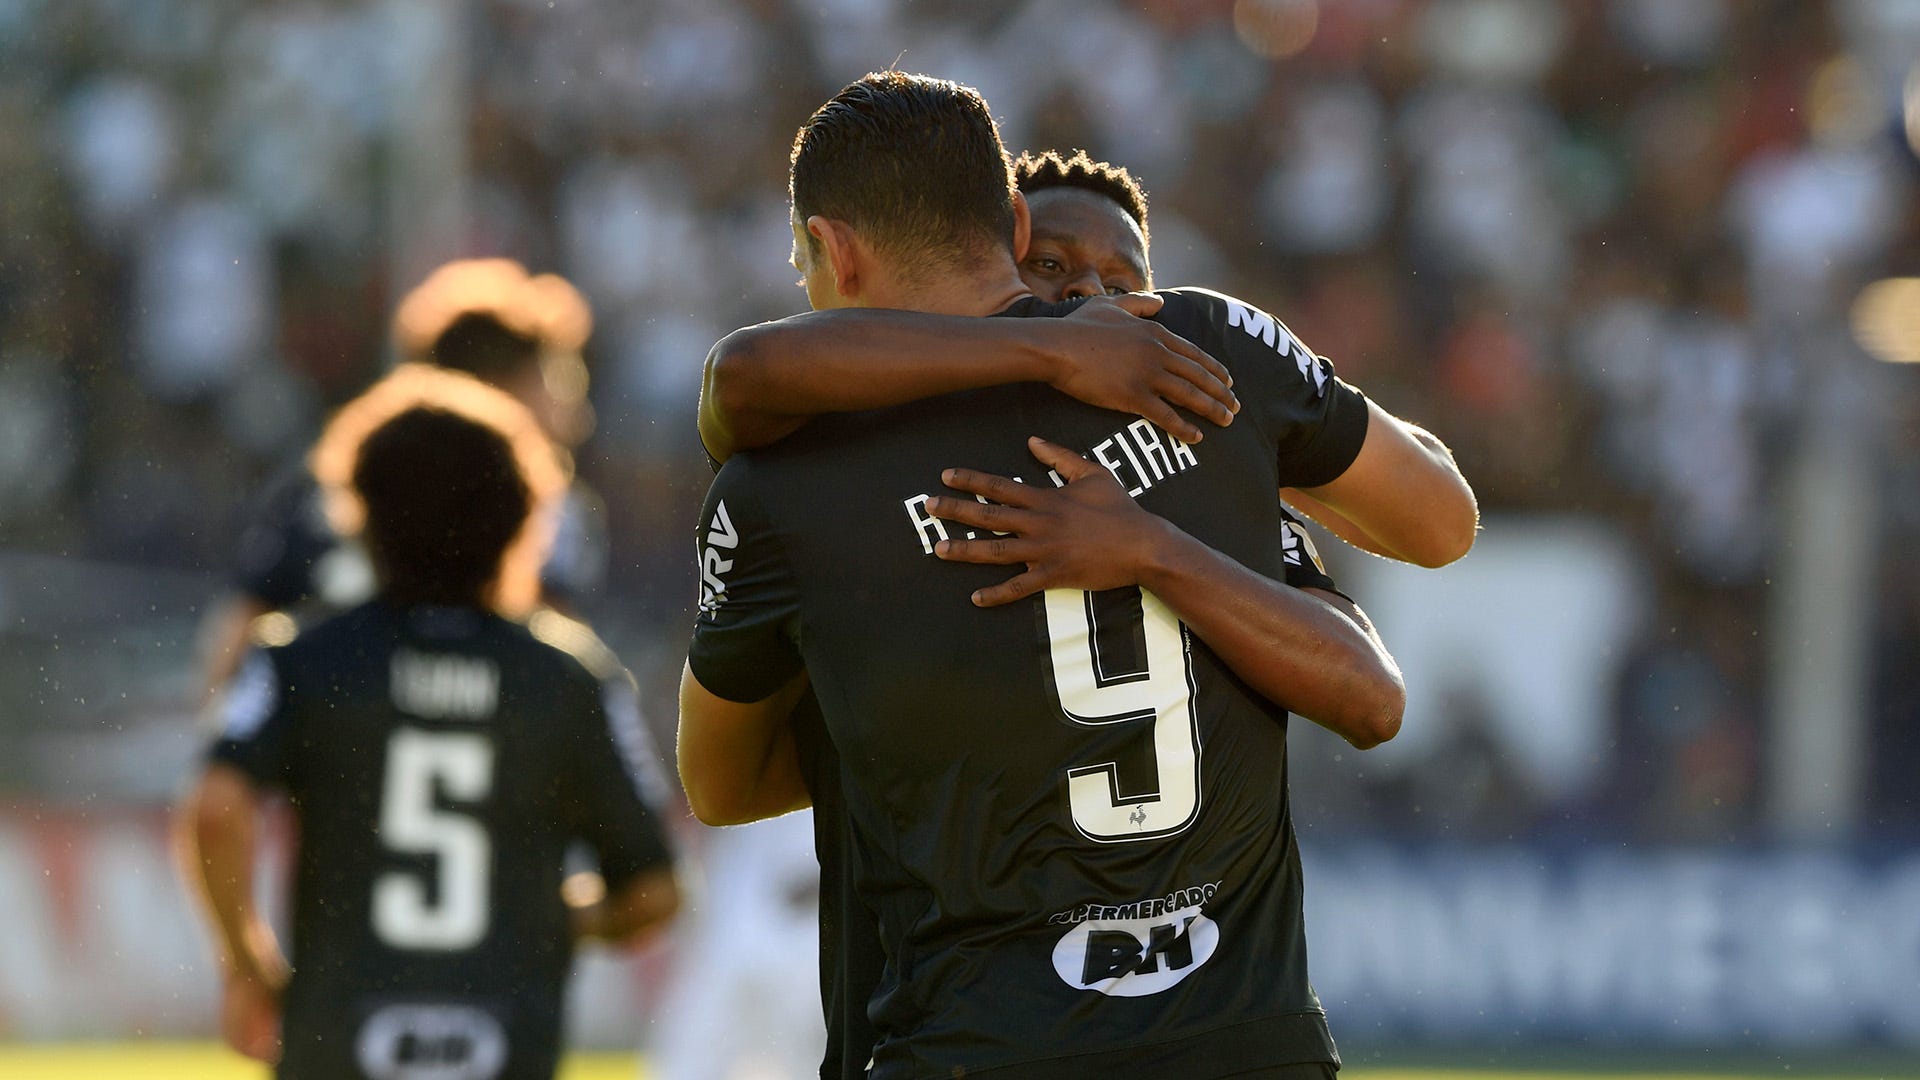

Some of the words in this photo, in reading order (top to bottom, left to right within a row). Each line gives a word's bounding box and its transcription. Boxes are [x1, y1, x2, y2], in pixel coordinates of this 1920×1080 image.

[1044, 585, 1202, 844] 9
[370, 727, 496, 953] 5
[1081, 915, 1197, 987] BH
